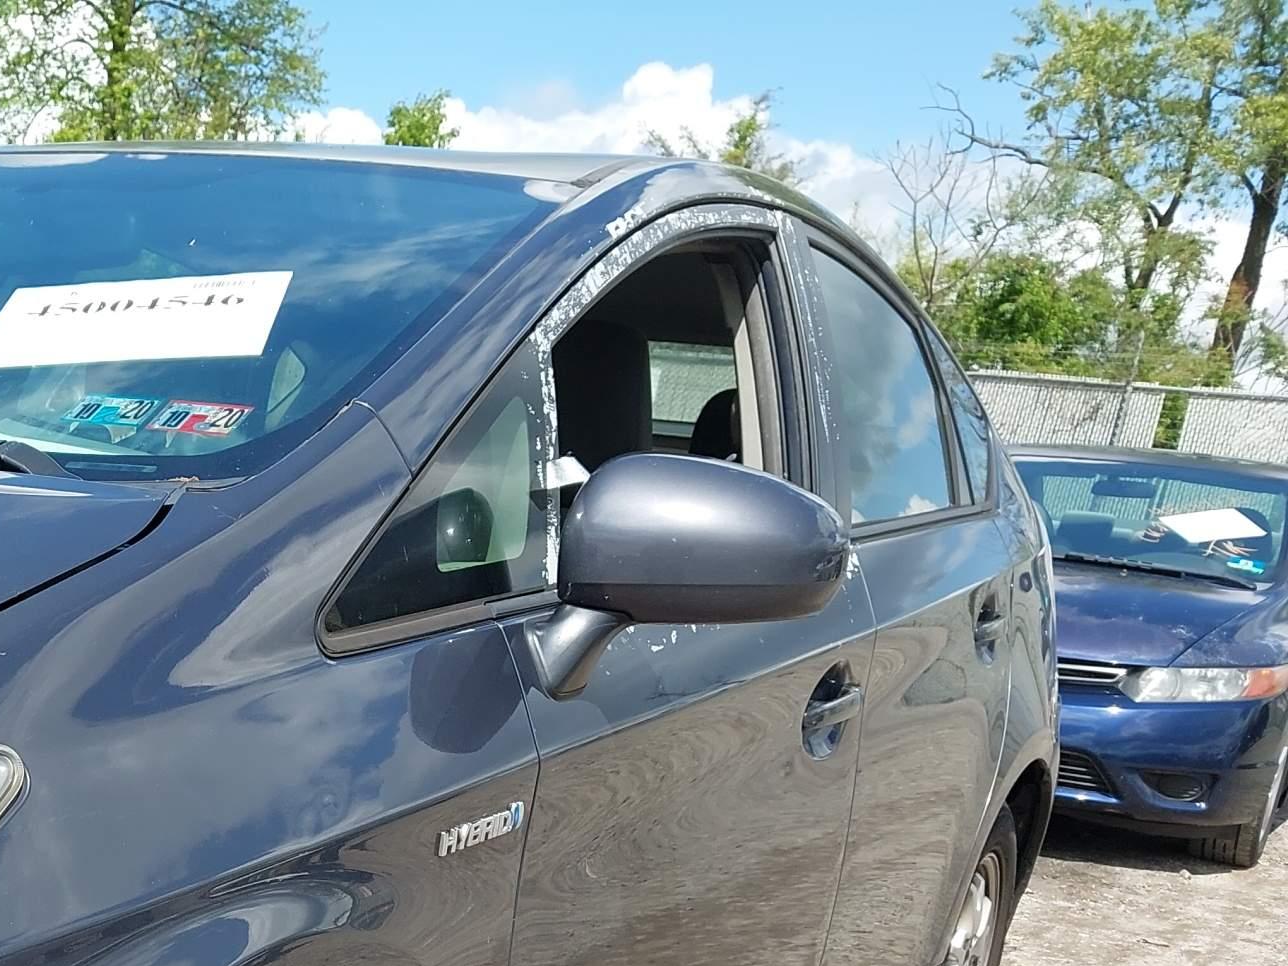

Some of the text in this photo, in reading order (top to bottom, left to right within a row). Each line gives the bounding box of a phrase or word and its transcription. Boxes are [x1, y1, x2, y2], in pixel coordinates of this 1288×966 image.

[120, 399, 156, 420] 20
[210, 407, 246, 429] 20
[438, 810, 513, 857] HYBRID
